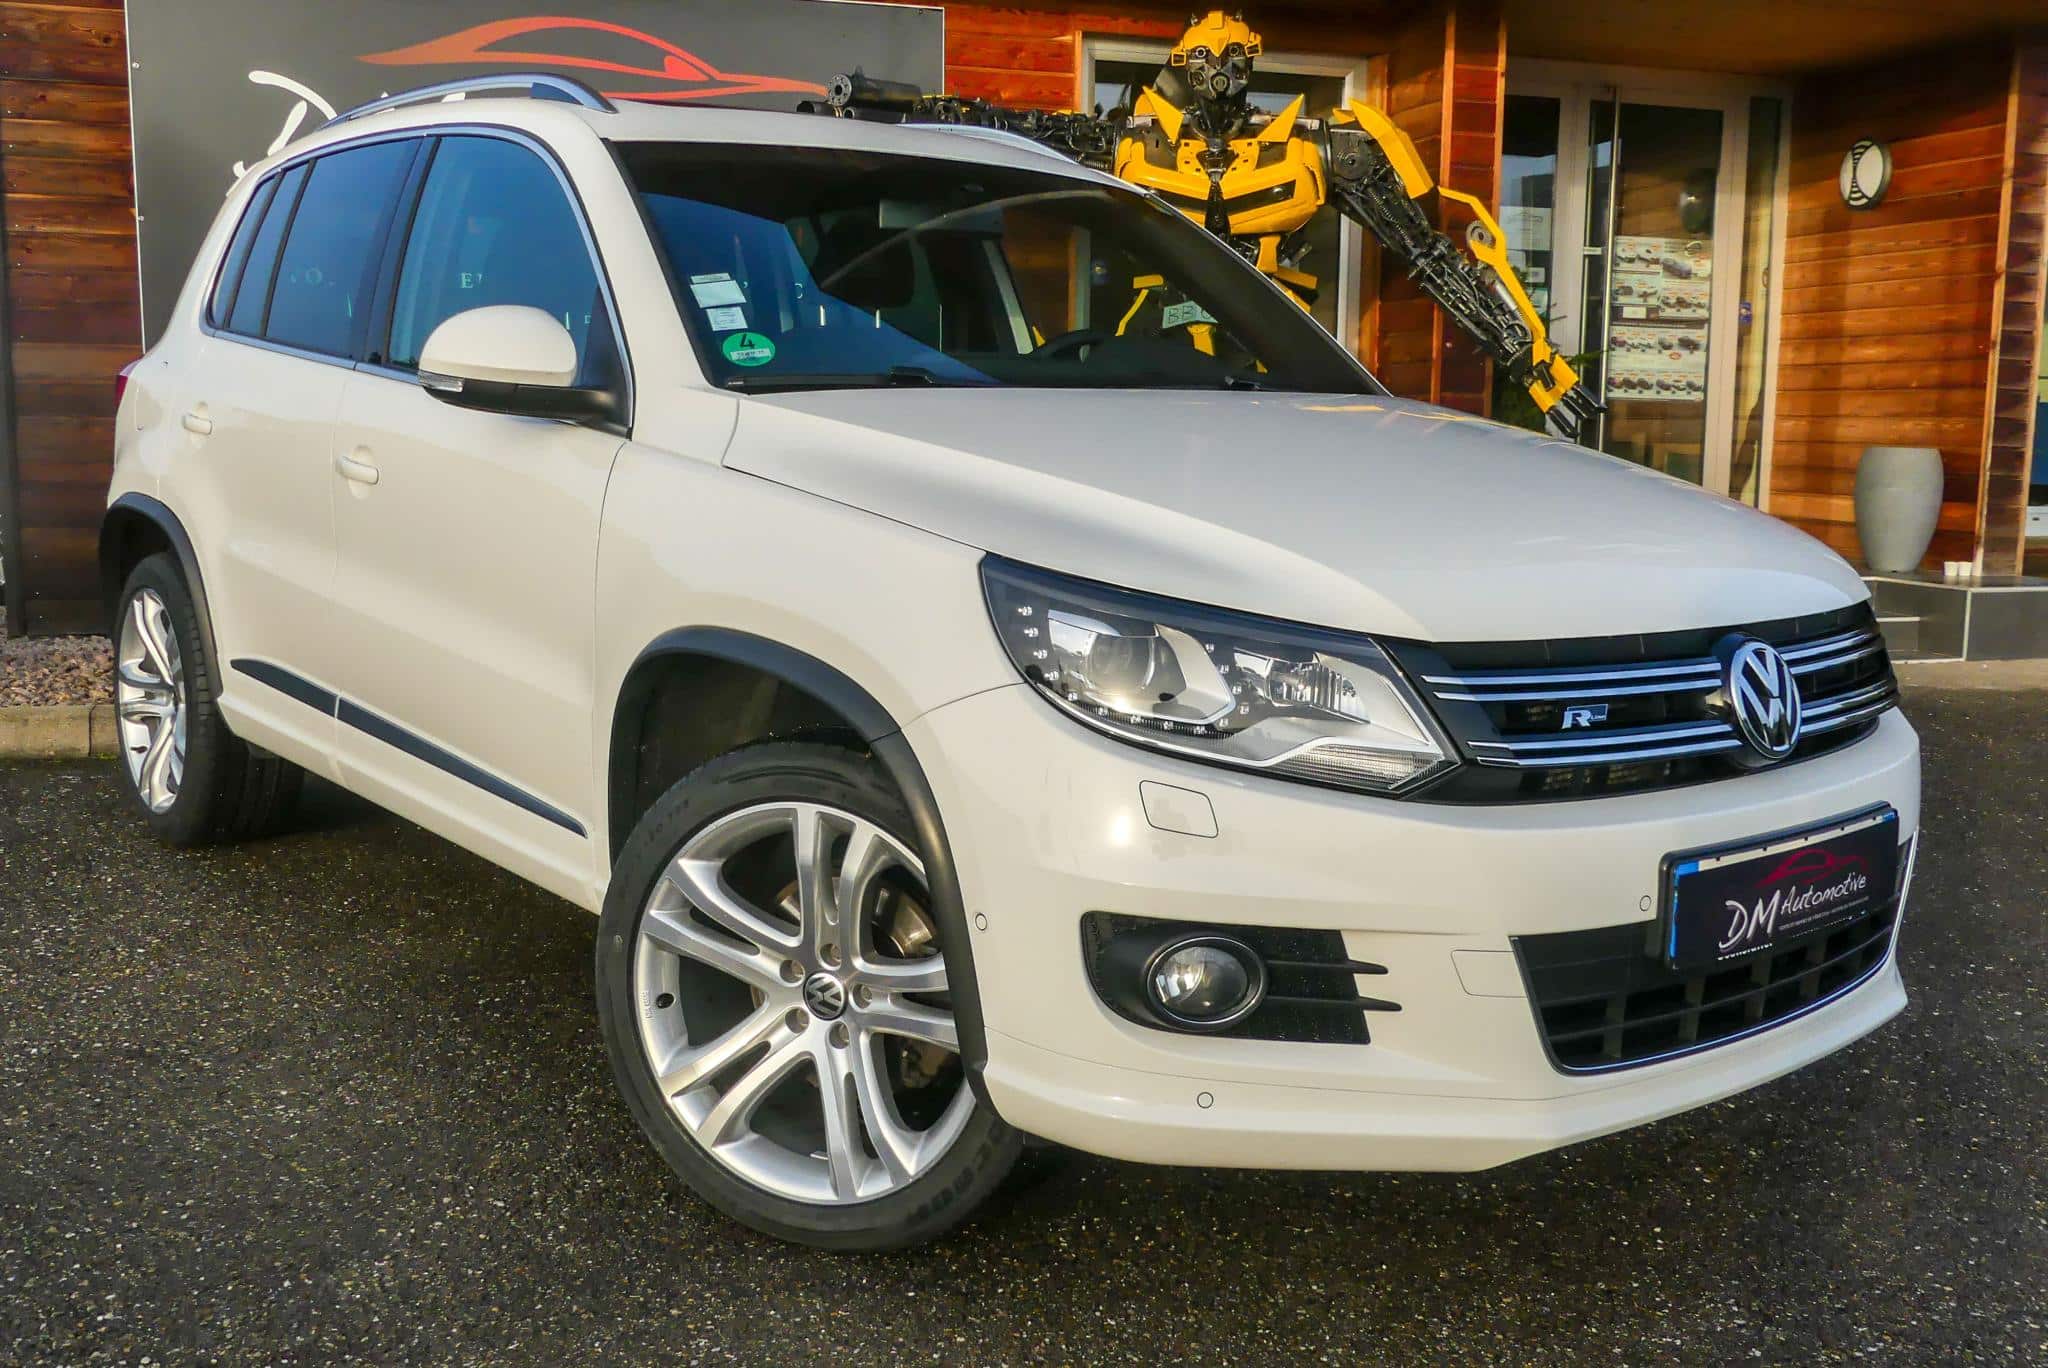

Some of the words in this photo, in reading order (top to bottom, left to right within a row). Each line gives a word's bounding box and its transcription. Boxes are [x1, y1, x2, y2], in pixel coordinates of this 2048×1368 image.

[740, 333, 755, 349] 4
[1561, 709, 1592, 729] R
[1718, 889, 1781, 949] DM
[1780, 871, 1867, 916] Automotive
